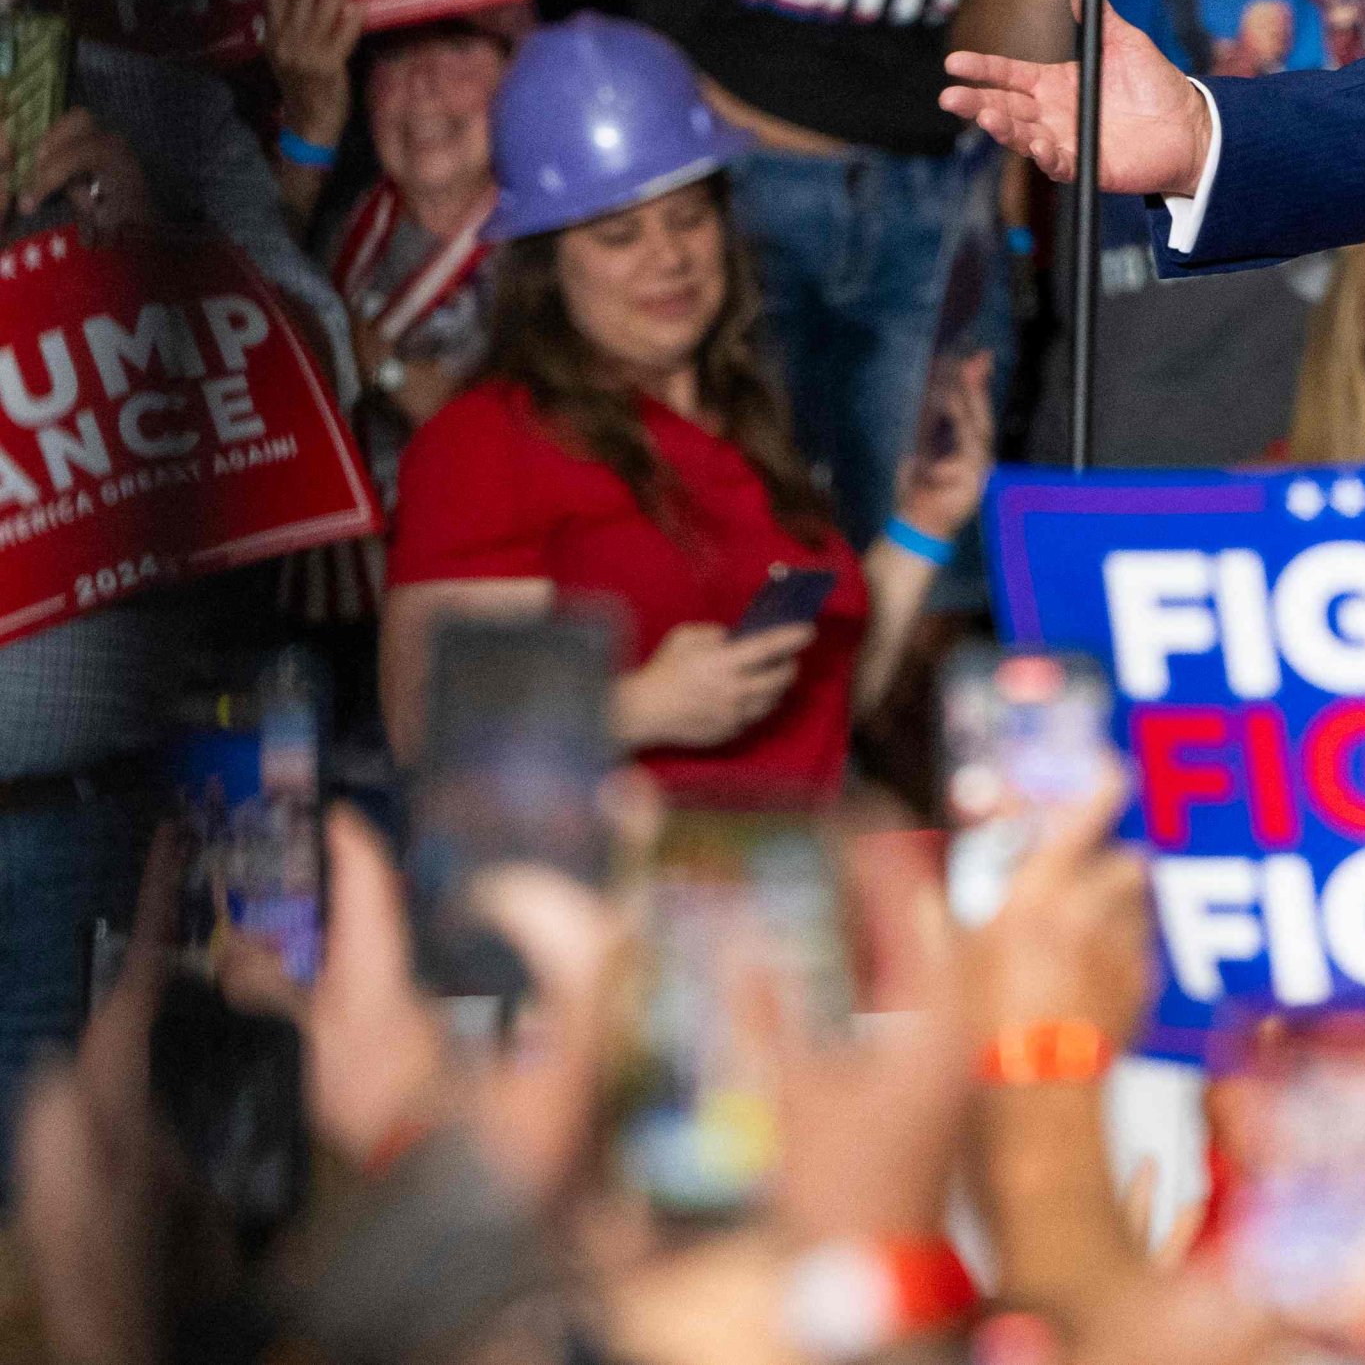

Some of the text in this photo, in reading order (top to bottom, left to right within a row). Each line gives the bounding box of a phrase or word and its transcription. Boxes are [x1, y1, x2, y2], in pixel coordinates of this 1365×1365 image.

[0, 292, 270, 429] UMP
[98, 460, 203, 507] GREAT
[213, 432, 299, 477] AGAIN!
[73, 553, 158, 609] 2024
